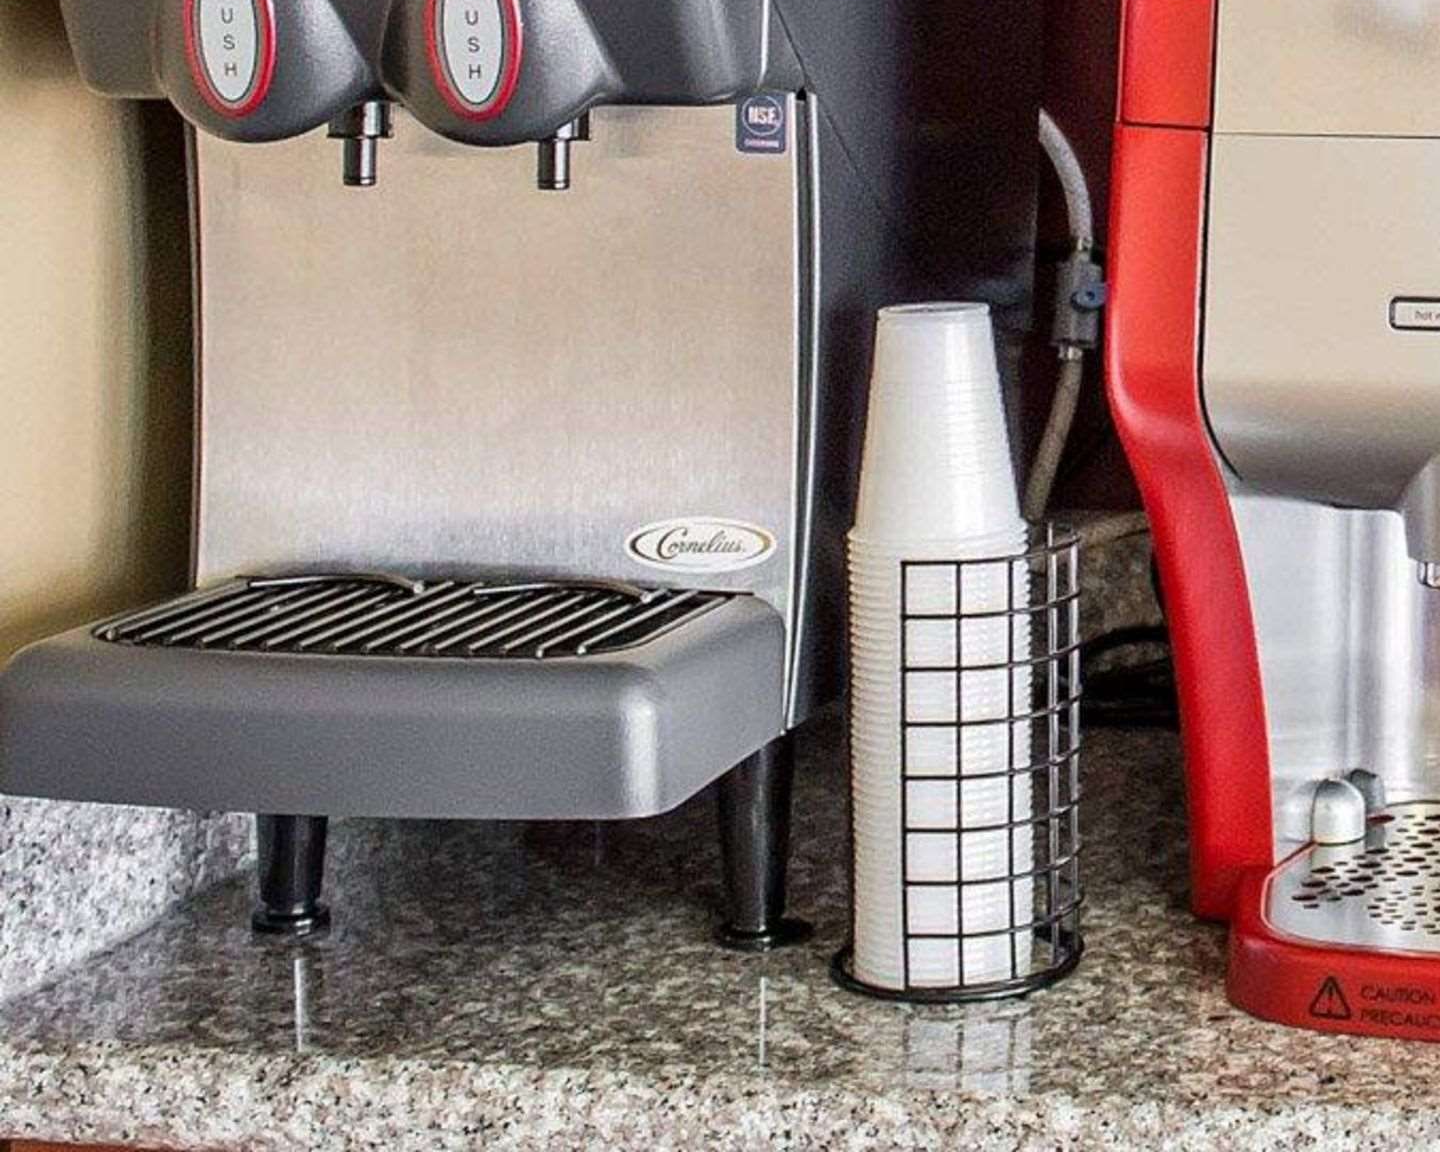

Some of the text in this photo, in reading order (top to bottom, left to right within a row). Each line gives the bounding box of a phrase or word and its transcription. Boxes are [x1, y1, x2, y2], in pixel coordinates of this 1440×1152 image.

[1414, 310, 1432, 321] hot
[656, 526, 743, 560] Cornelius
[1360, 985, 1435, 1005] CAUTION
